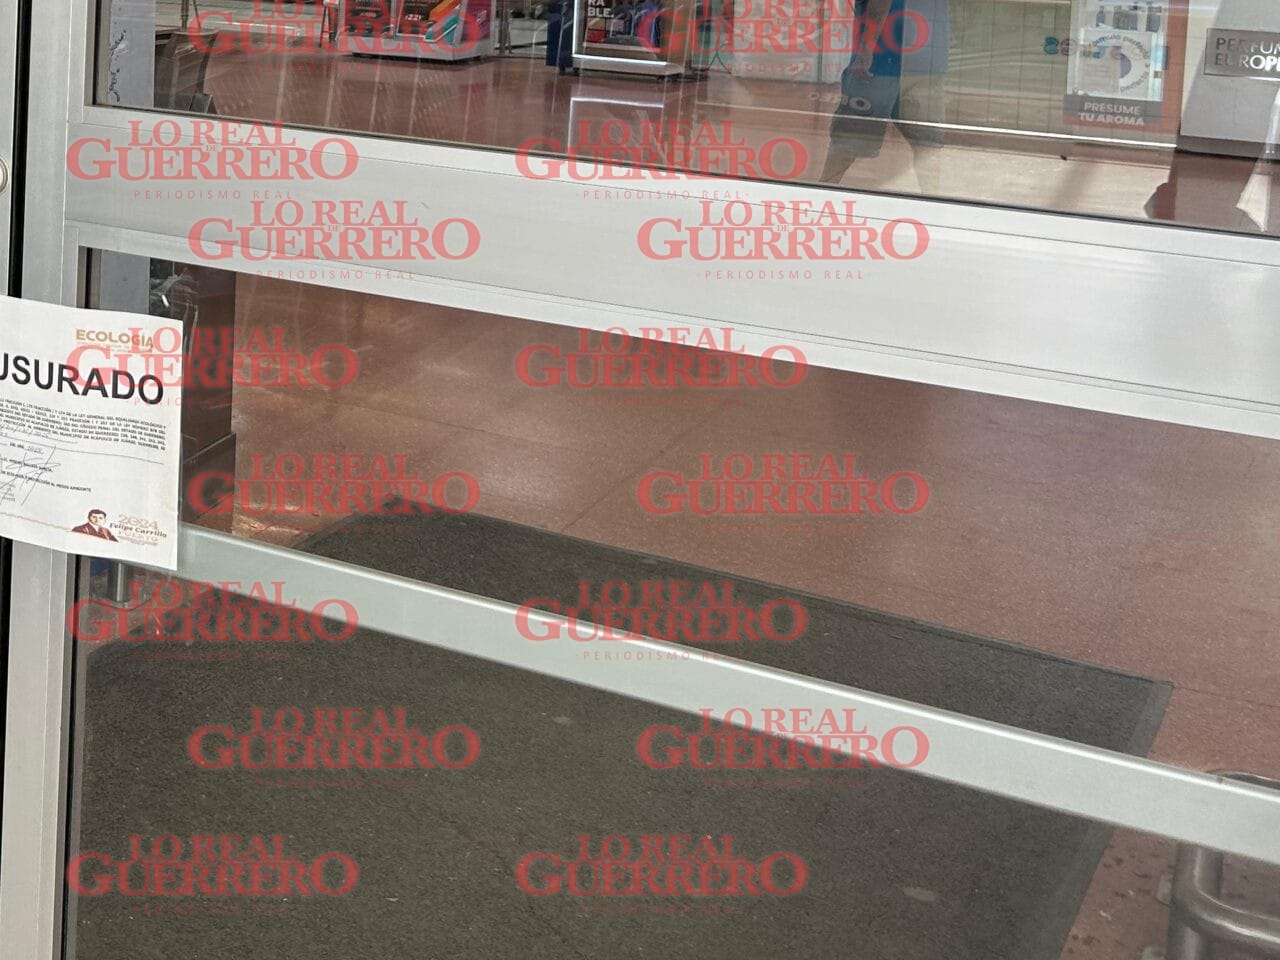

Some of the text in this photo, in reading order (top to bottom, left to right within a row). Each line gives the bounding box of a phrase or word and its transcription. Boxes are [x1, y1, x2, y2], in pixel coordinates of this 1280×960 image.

[1084, 102, 1141, 114] PRESUME
[1079, 112, 1144, 125] TU AROMA
[109, 523, 167, 538] Felipe Carrillo
